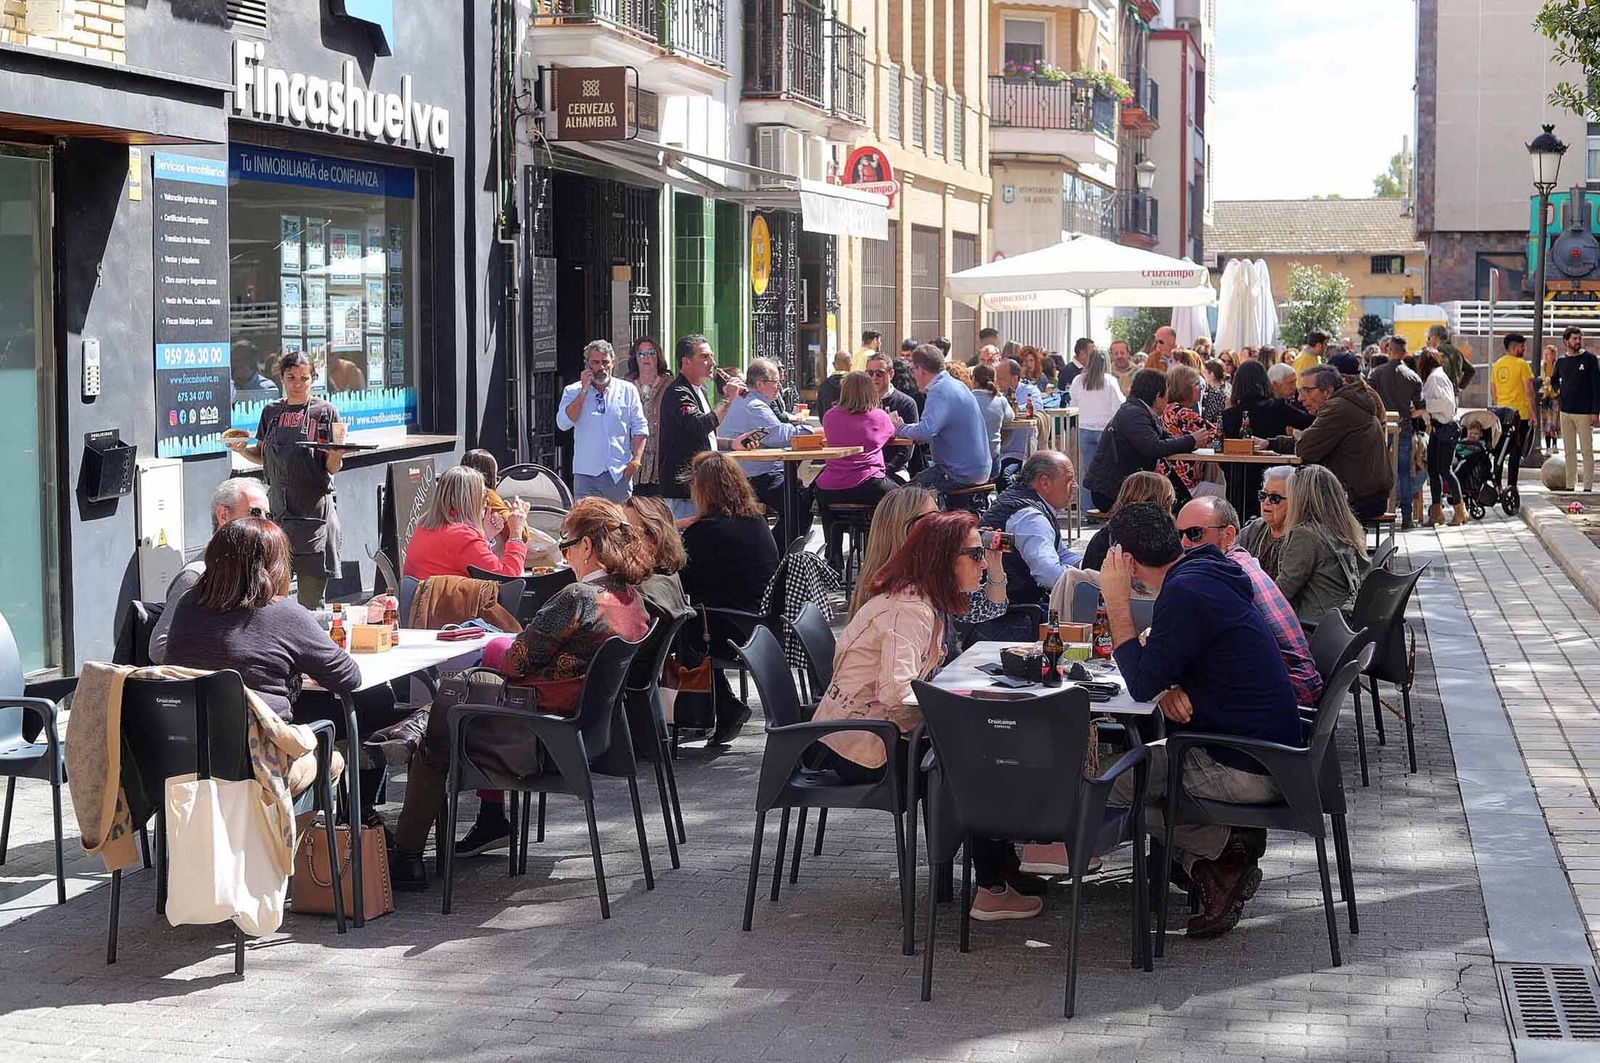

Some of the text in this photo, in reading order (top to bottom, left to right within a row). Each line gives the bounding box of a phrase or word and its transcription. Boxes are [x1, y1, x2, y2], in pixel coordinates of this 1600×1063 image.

[234, 39, 449, 151] Fincashuelva
[568, 102, 615, 115] CERVEZAS
[565, 115, 618, 129] ALHAMBRA
[156, 159, 225, 177] Servicios Inmobiliarios
[240, 153, 379, 187] Tu INMOBILIARIA de CONFIANZA
[164, 347, 222, 365] 959 26 30 00
[169, 372, 219, 385] www.fincashuelva.es
[177, 390, 213, 402] 675 34 07 01
